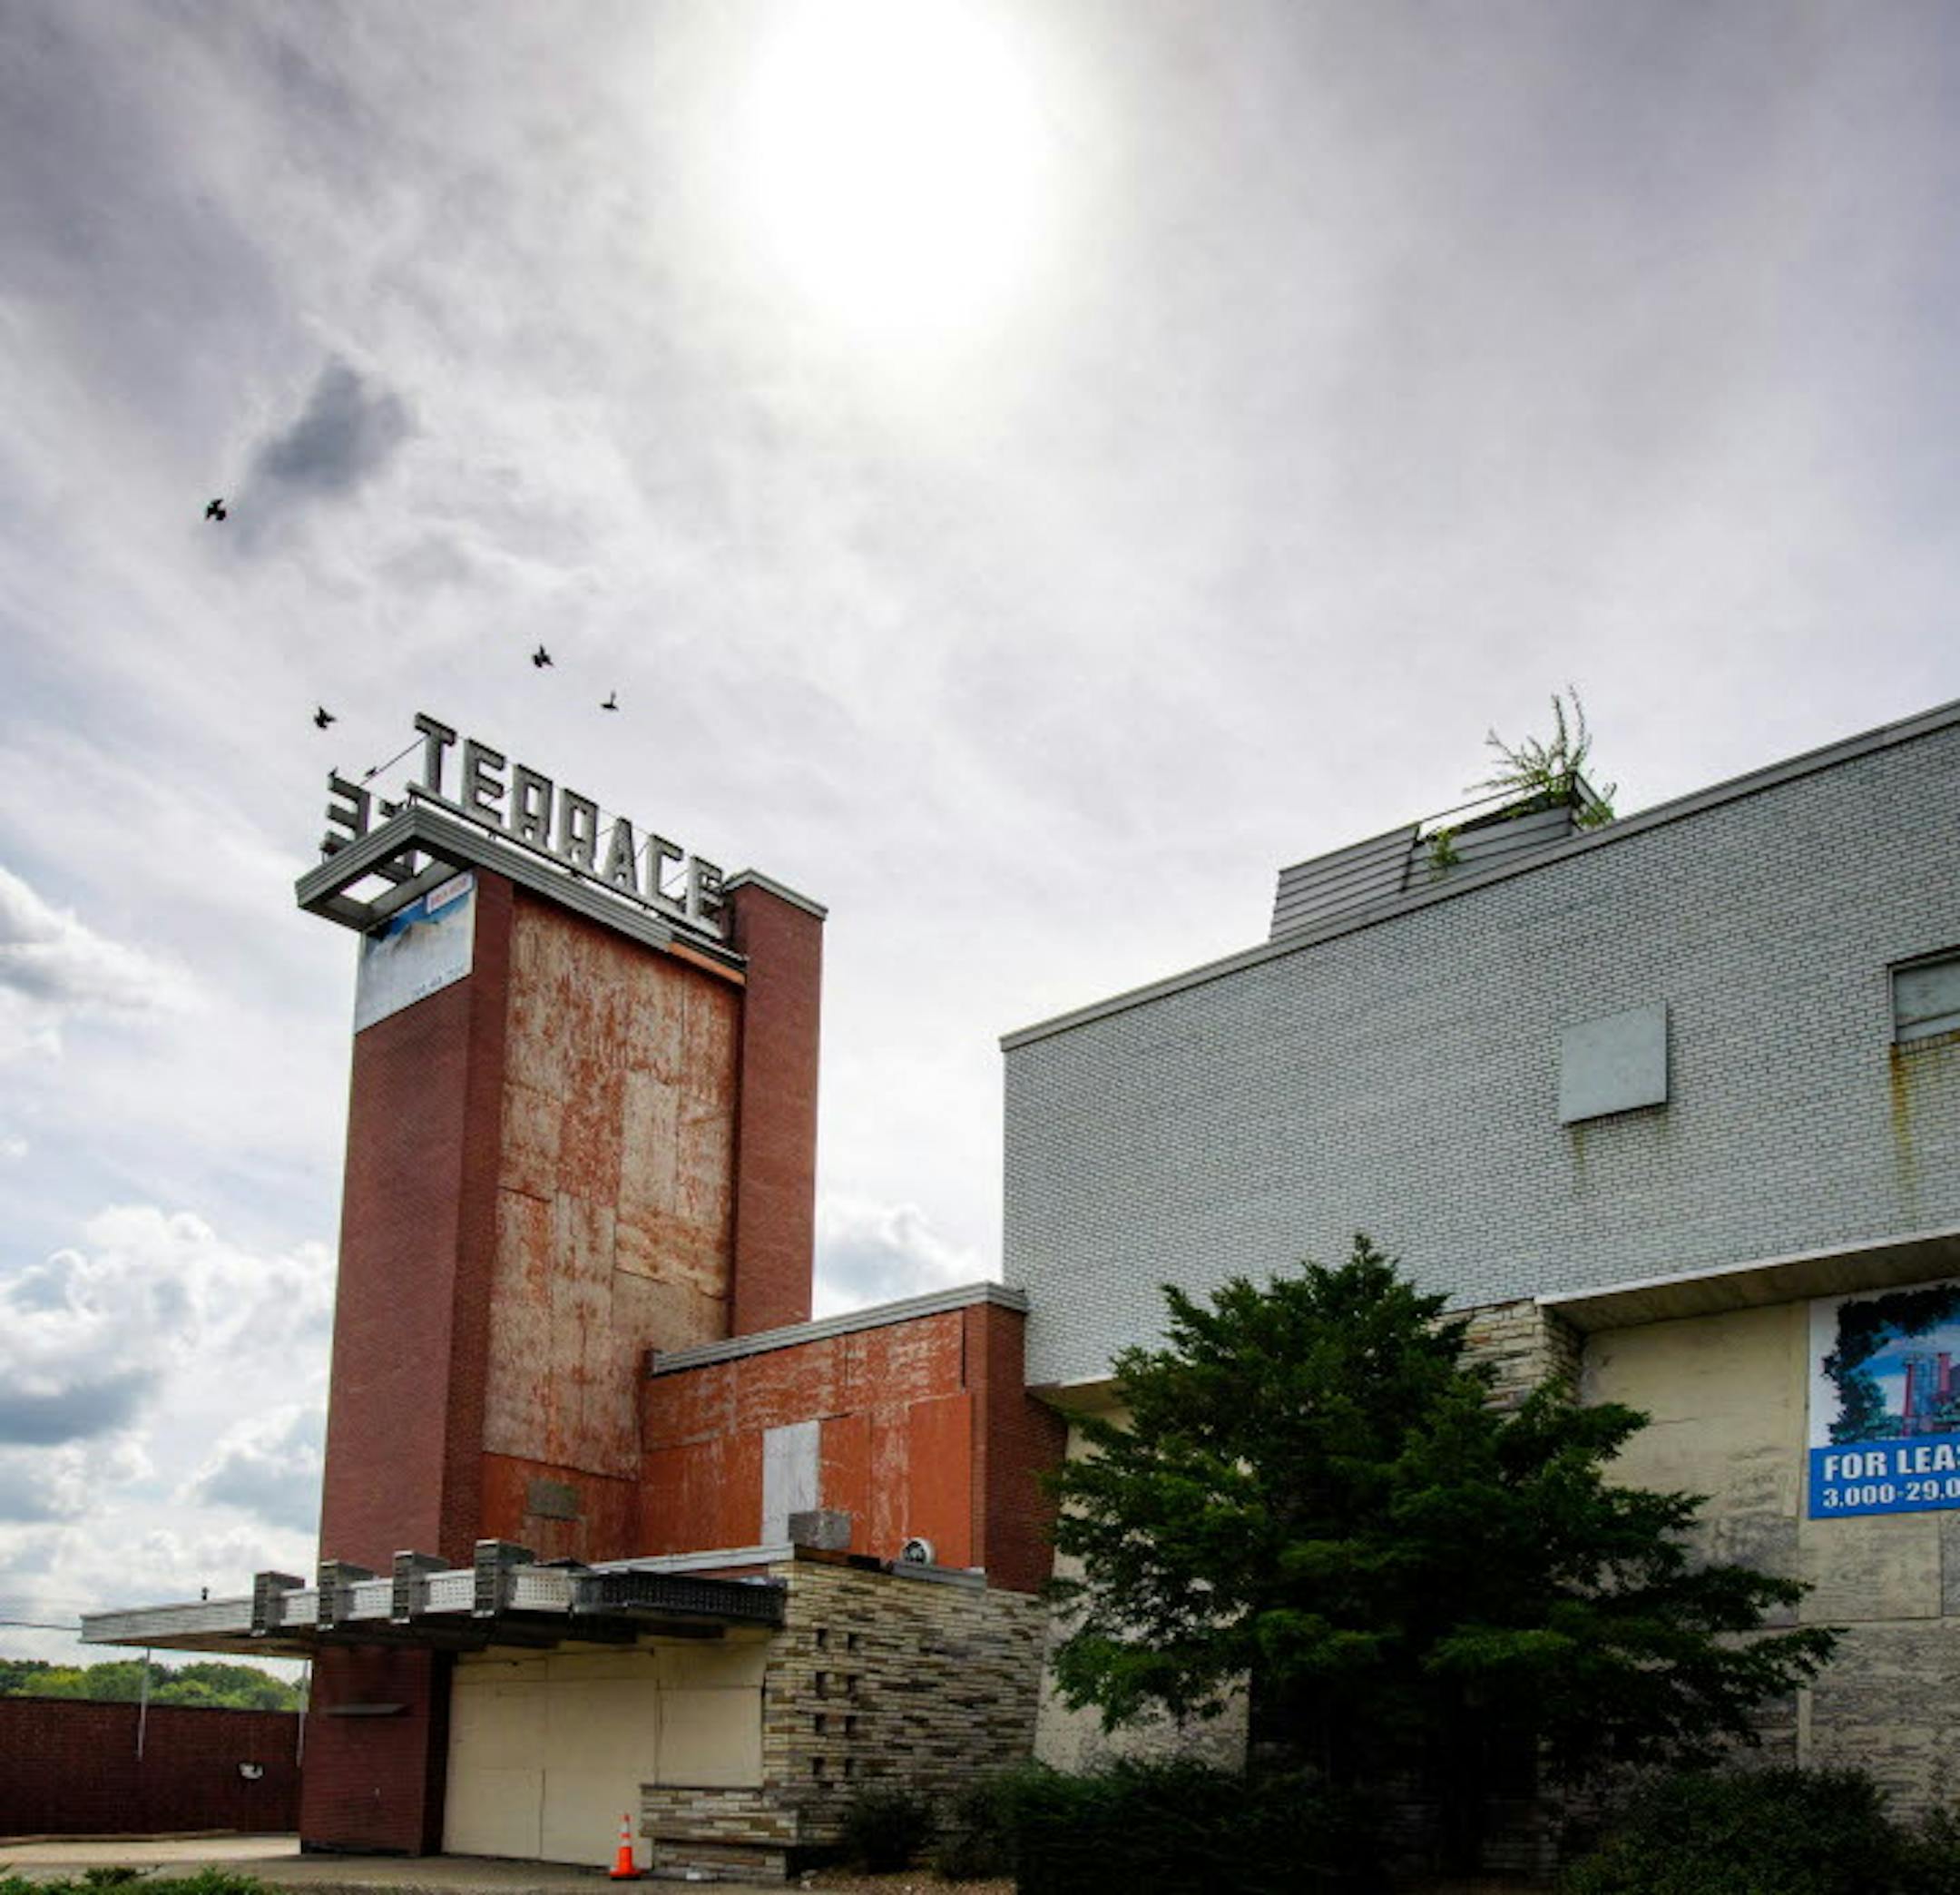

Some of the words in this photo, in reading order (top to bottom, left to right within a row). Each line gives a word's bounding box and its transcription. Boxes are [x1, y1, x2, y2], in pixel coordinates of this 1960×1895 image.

[415, 712, 723, 938] TERRACE
[1825, 1453, 1887, 1481] FOR
[1897, 1444, 1960, 1474] LEA
